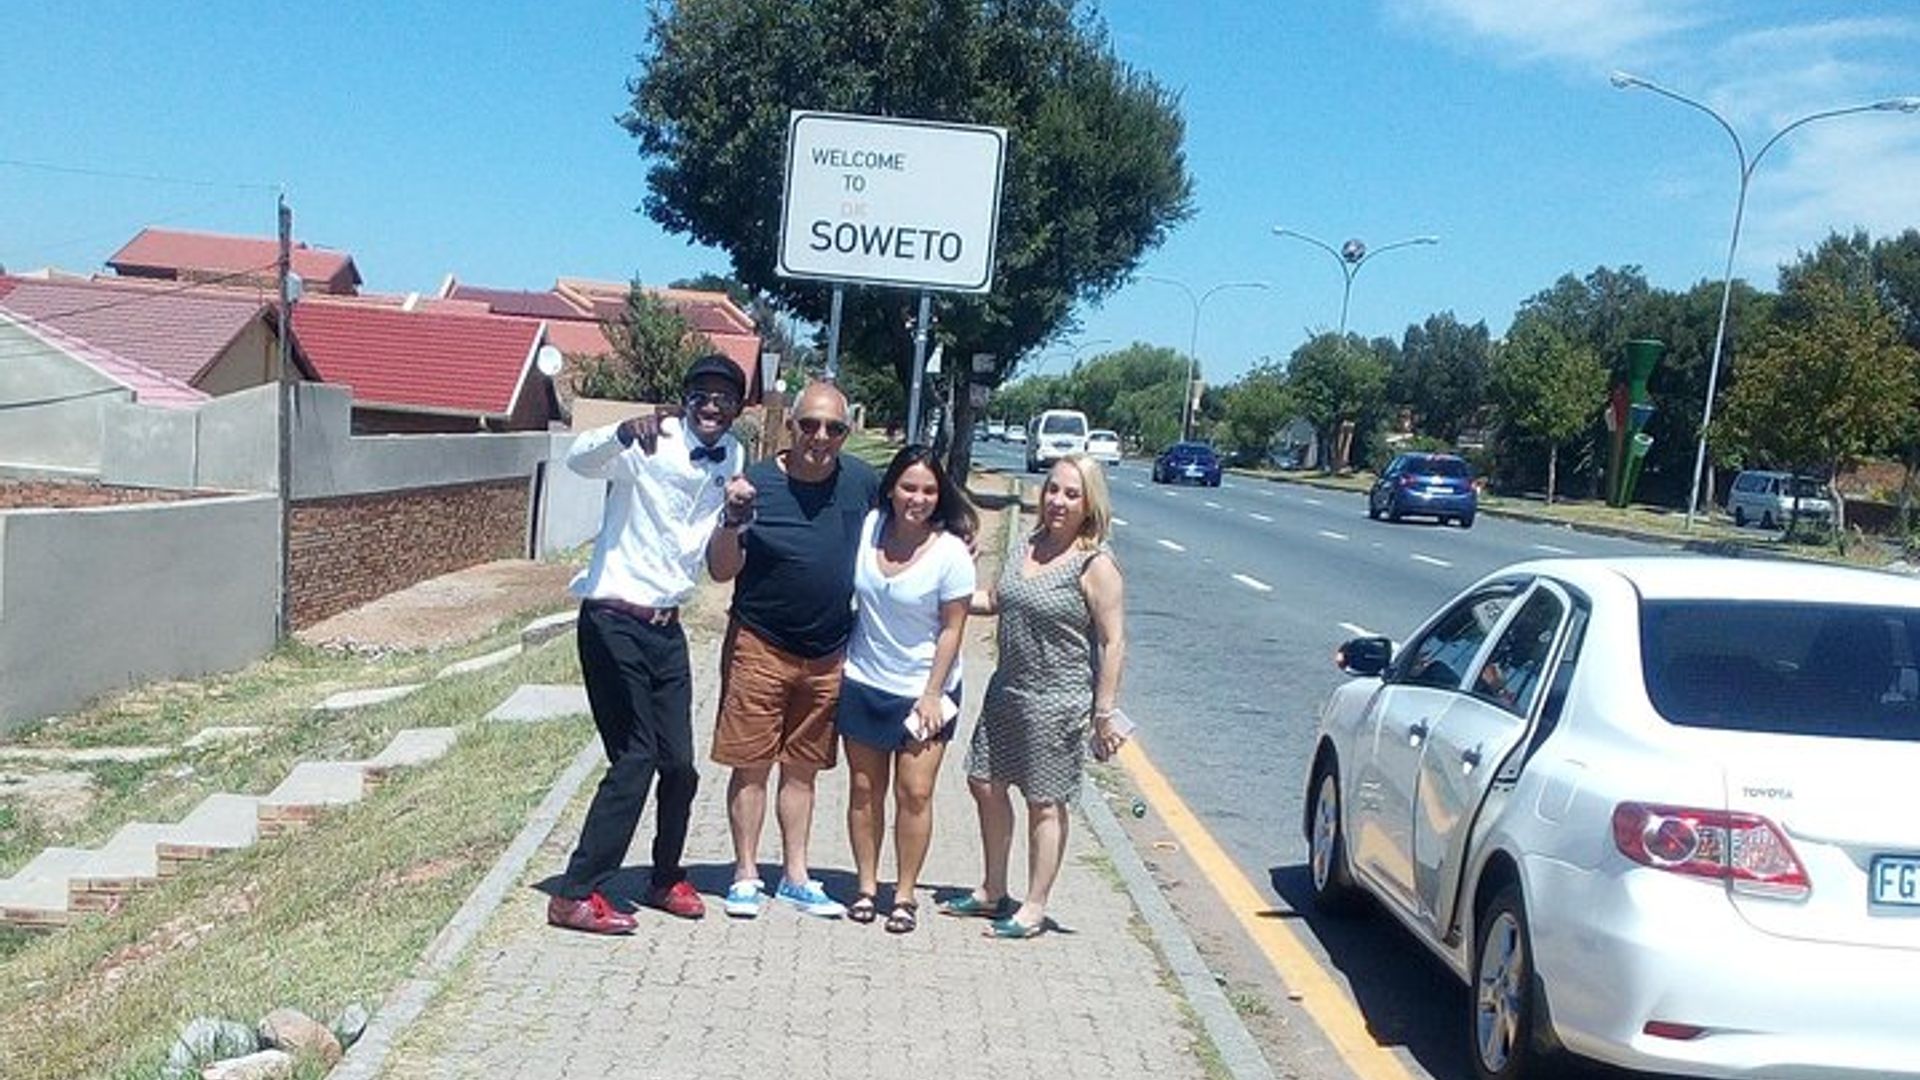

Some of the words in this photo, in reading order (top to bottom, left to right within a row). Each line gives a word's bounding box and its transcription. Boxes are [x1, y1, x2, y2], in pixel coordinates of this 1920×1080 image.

[812, 148, 906, 171] WELCOME
[843, 174, 866, 192] TO
[809, 220, 963, 263] SOWETO
[1742, 786, 1794, 800] TOYOTA
[1879, 863, 1920, 898] FG
